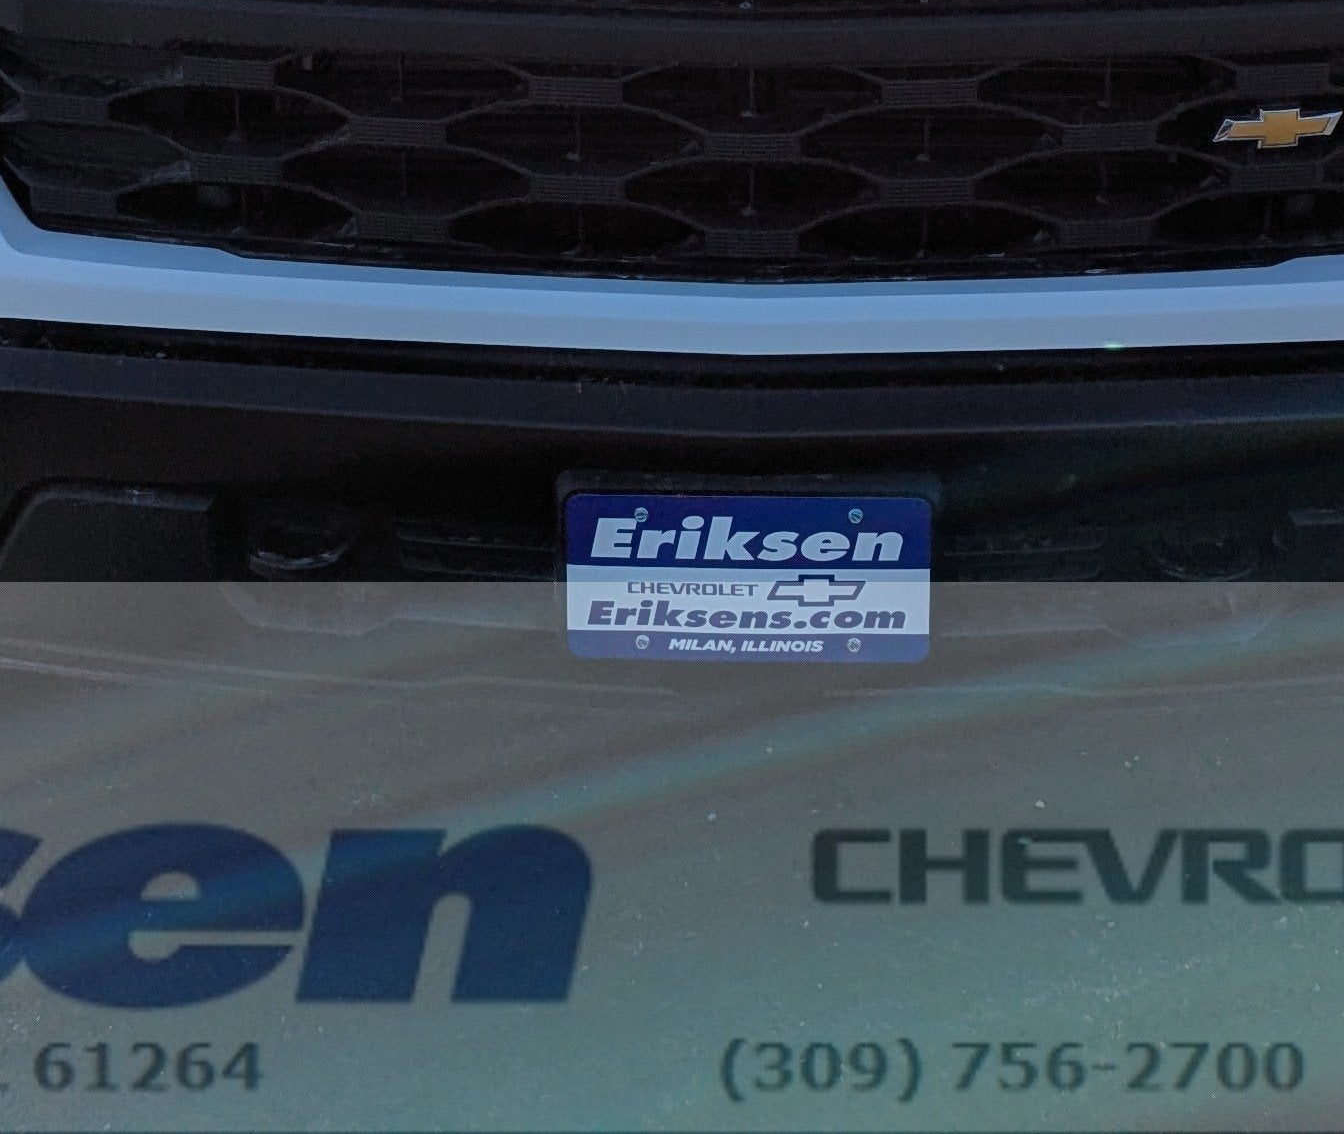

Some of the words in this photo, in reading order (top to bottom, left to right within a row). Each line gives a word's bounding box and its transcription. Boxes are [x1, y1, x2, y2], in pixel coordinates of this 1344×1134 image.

[590, 516, 904, 563] Eriksen
[627, 581, 759, 597] CHEVROLET
[587, 600, 906, 630] Eriksens.com
[668, 638, 736, 654] MILAN,
[740, 639, 825, 654] ILLINOIS
